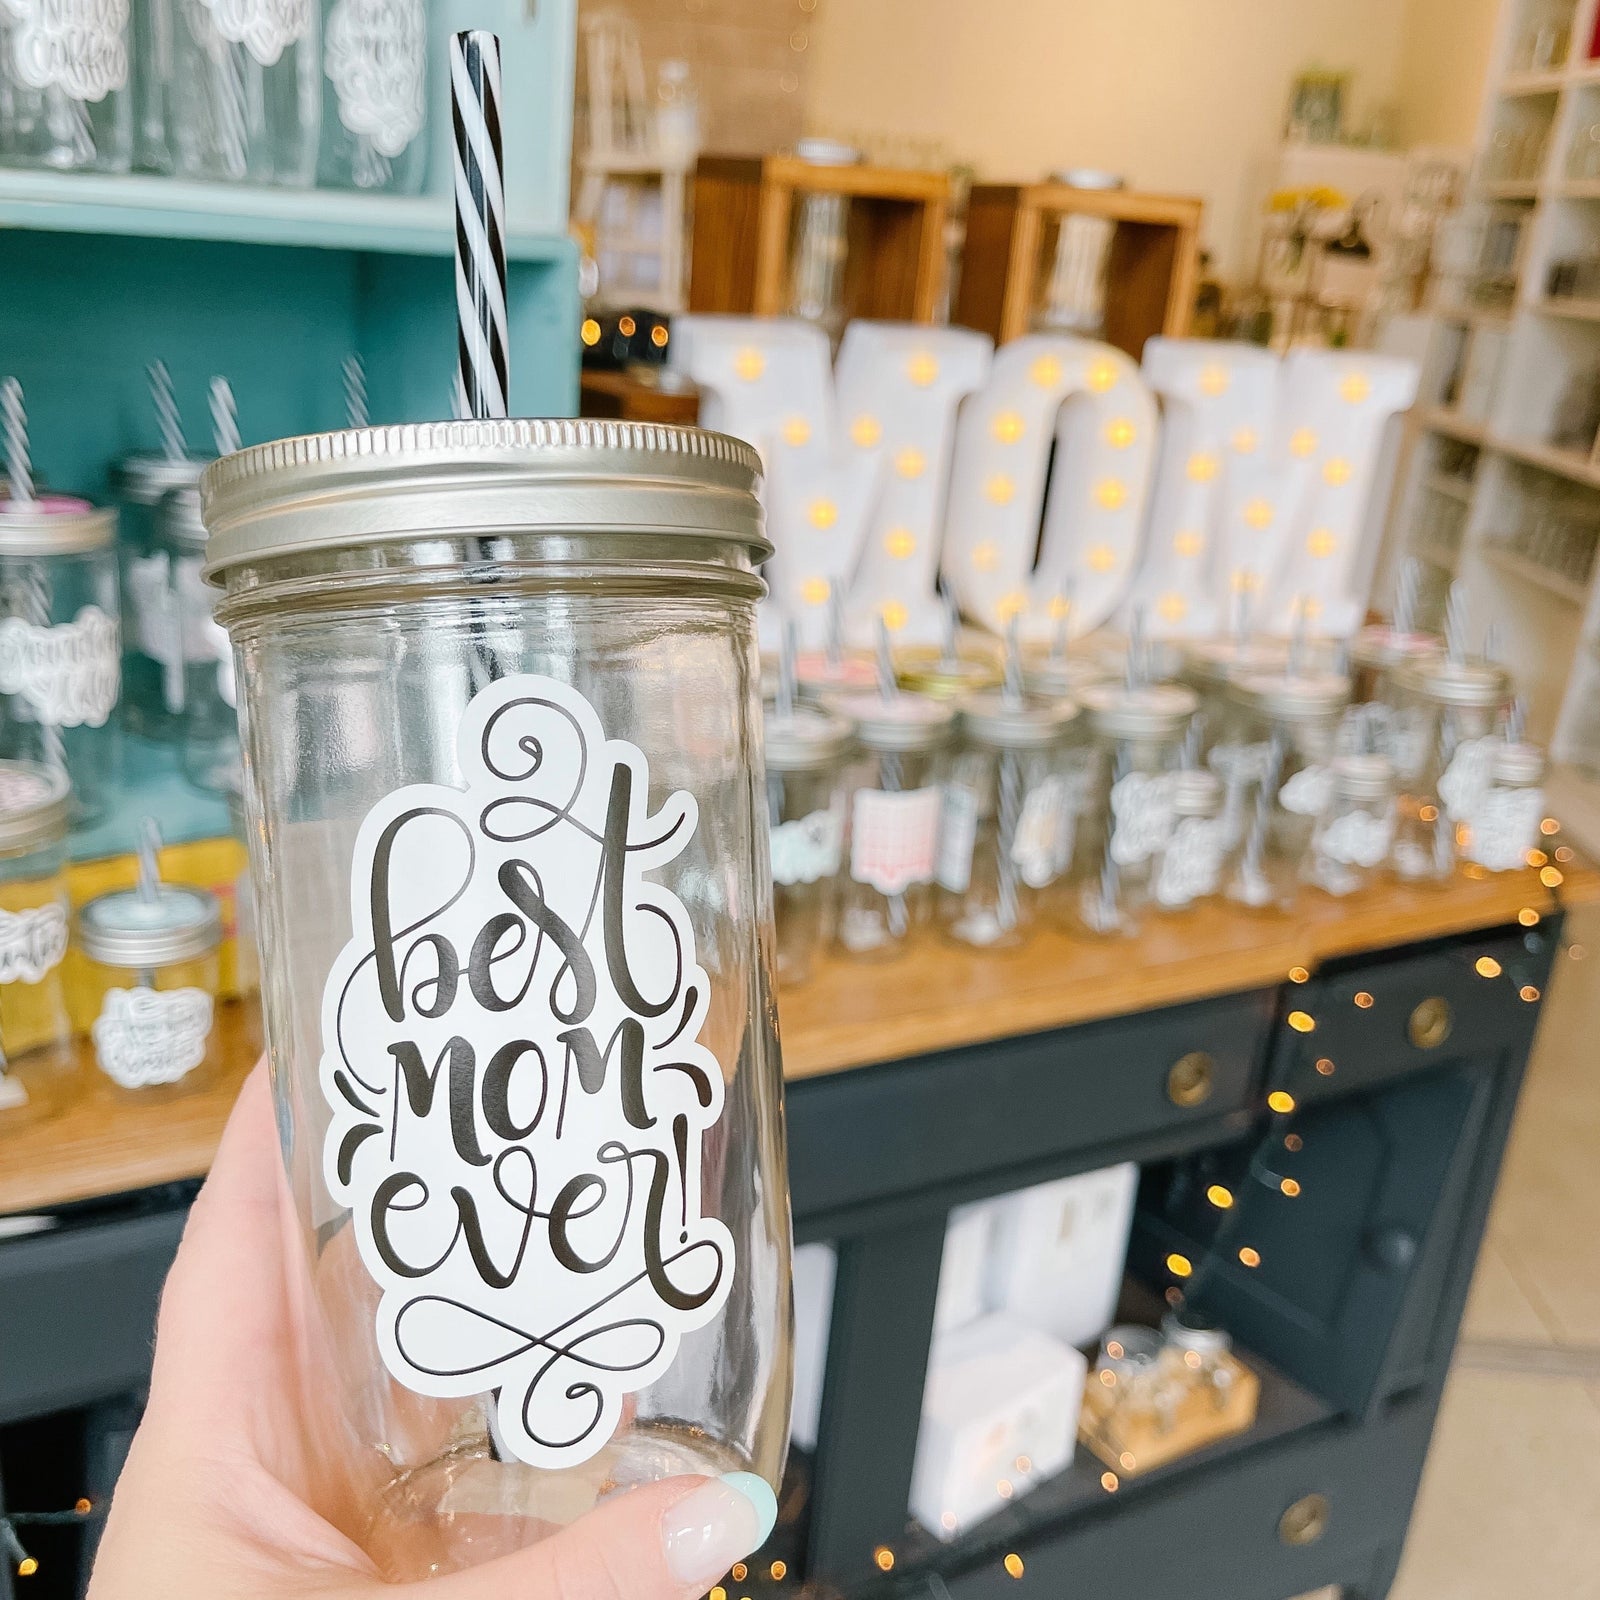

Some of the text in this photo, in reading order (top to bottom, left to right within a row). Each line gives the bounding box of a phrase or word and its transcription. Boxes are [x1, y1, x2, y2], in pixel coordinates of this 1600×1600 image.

[668, 313, 1418, 645] MOM
[340, 762, 705, 1026] best
[370, 1112, 722, 1311] ever!
